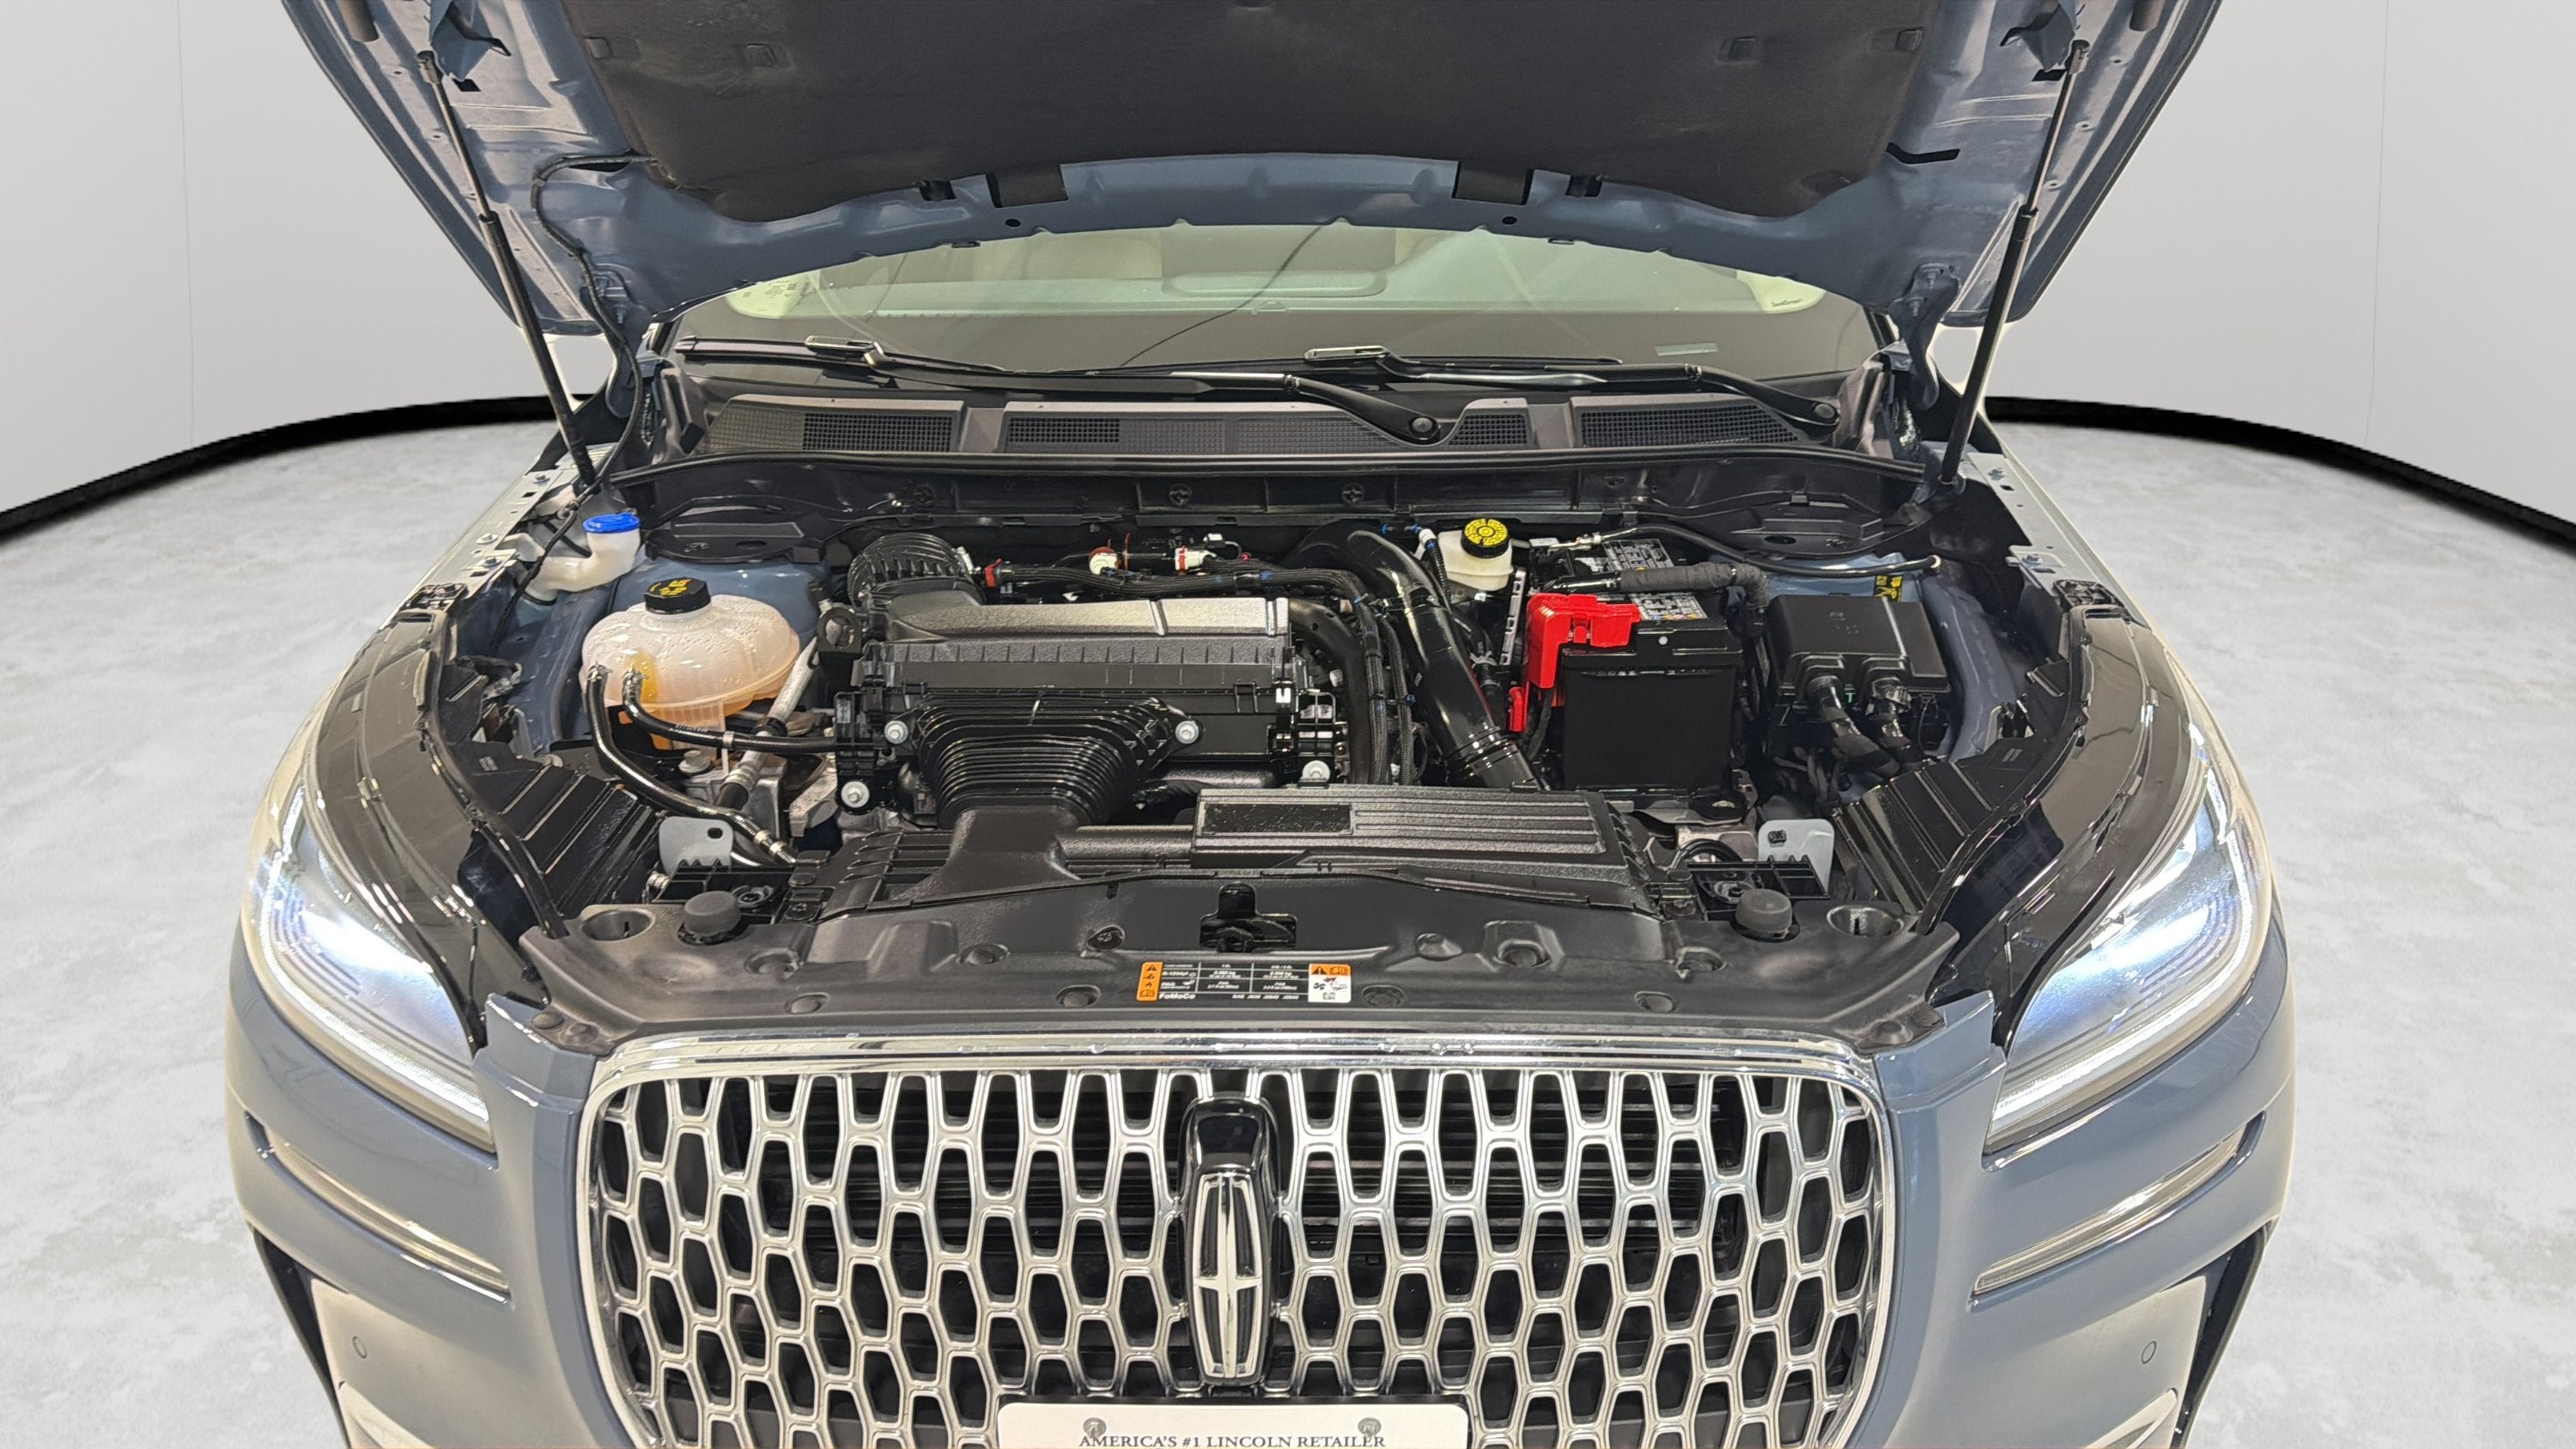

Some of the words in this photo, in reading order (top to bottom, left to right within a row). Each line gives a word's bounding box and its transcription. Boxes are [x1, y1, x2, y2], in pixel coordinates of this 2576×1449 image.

[1078, 1435, 1177, 1447] AMERICA'S
[1182, 1436, 1200, 1447] #1
[1206, 1435, 1291, 1447] LINCOLN
[1297, 1435, 1386, 1448] RETAILER
